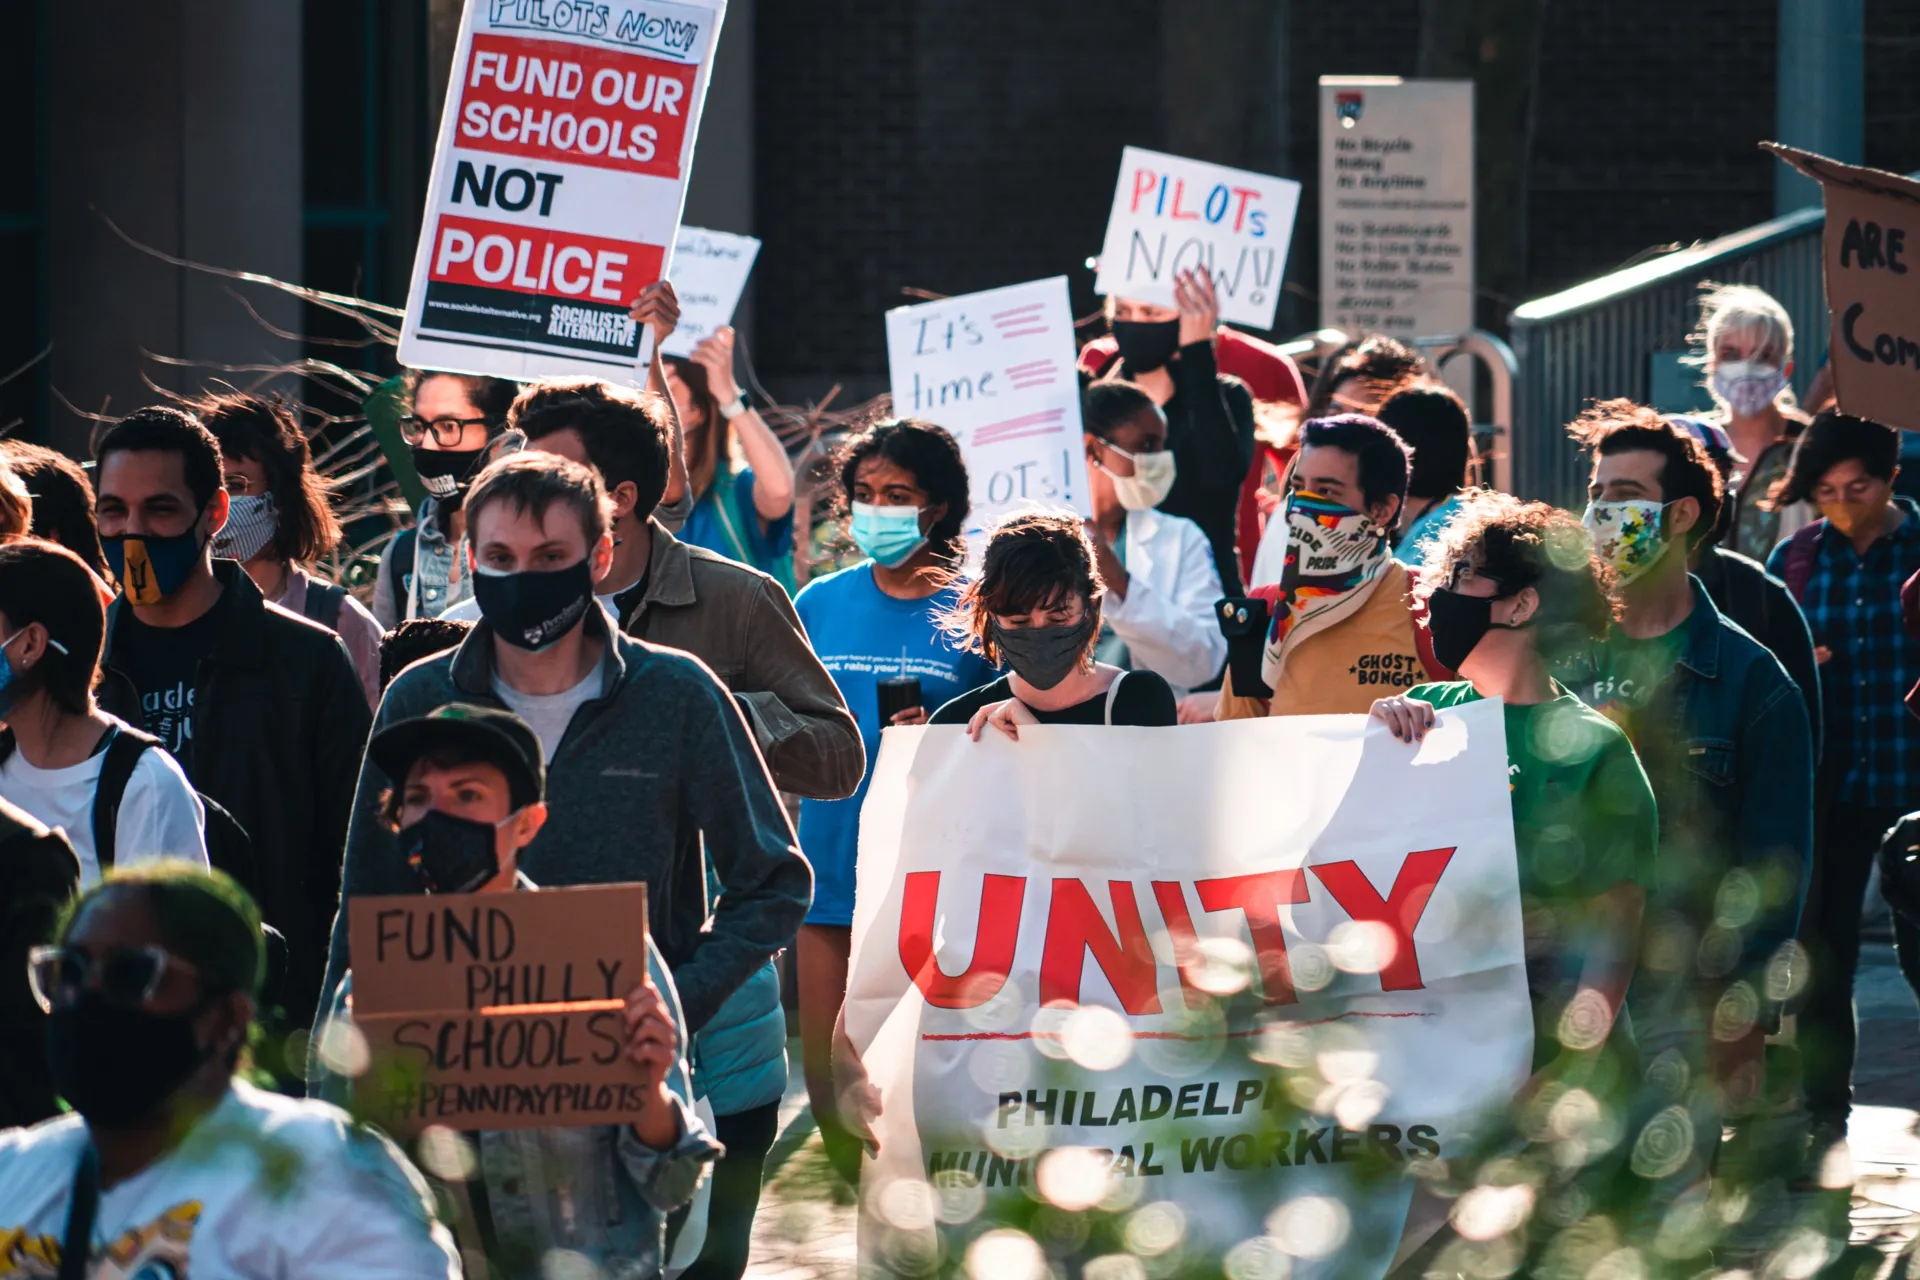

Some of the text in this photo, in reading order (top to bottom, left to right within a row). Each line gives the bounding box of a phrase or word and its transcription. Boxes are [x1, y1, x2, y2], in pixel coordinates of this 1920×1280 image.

[489, 0, 699, 52] PILOTS NOW!
[470, 51, 684, 116] FUND OUR
[461, 101, 658, 162] SCHOOLS
[450, 160, 564, 217] NOT
[435, 227, 629, 301] POLICE
[1840, 217, 1908, 274] ARE
[547, 320, 635, 347] ALTERNATIVE
[550, 304, 627, 328] SOCIALIST
[910, 312, 984, 356] It's
[906, 370, 998, 411] time
[974, 449, 1073, 510] OTs!
[1306, 556, 1339, 570] PRIDE
[844, 661, 872, 672] raise
[872, 663, 900, 674] your
[1358, 652, 1416, 672] GHOST
[1358, 669, 1414, 687] BONGO
[376, 906, 516, 963] FUND
[898, 846, 1458, 1016] UNITY
[466, 958, 622, 1011] PHILLY
[392, 1011, 622, 1072] SCHOOLS
[1179, 1123, 1442, 1175] WORKERS
